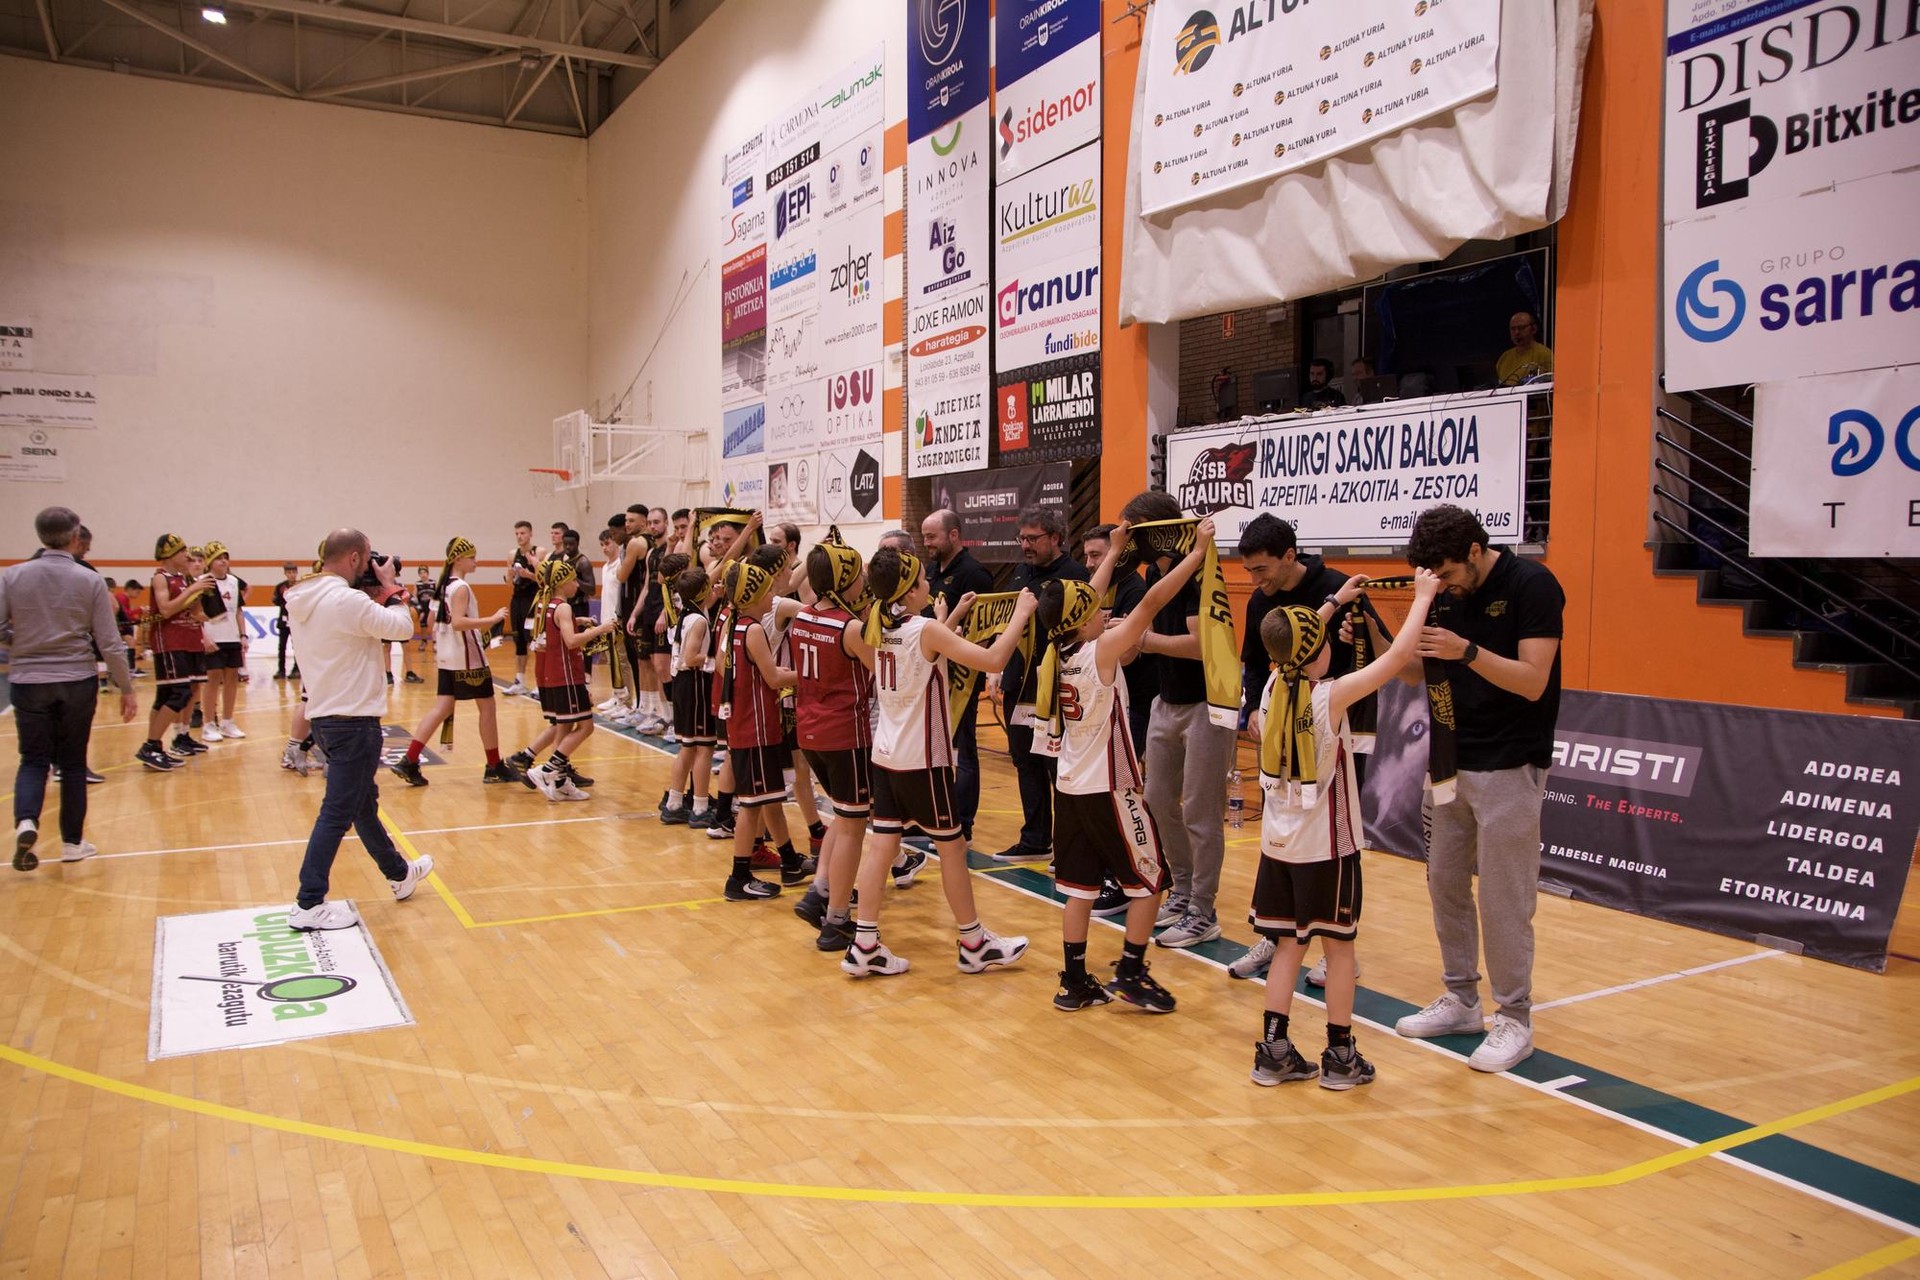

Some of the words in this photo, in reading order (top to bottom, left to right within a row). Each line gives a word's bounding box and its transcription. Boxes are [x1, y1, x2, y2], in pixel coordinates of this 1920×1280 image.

[1334, 34, 1360, 53] ALTUNA
[1366, 22, 1385, 37] URIA
[1377, 40, 1406, 60] ALTUNA
[1414, 28, 1434, 43] URIA
[1425, 46, 1456, 67] ALTUNA
[1464, 33, 1485, 50] URIA
[832, 64, 882, 109] alumak
[1245, 74, 1271, 90] ALTUNA
[1277, 64, 1293, 77] URIA
[1286, 83, 1314, 99] ALTUNA
[1321, 72, 1339, 85] URIA
[1332, 90, 1358, 108] ALTUNA
[1364, 79, 1383, 93] URIA
[1374, 99, 1403, 117] ALTUNA
[1411, 87, 1429, 101] URIA
[780, 102, 819, 140] CARMONA
[1017, 80, 1096, 143] sidenor
[1165, 107, 1191, 122] ALTUNA
[1195, 100, 1211, 111] URIA
[1204, 116, 1228, 131] ALTUNA
[1234, 108, 1249, 120] URIA
[1785, 87, 1920, 156] Bitxite
[1243, 126, 1269, 141] ALTUNA
[1275, 117, 1293, 129] URIA
[1287, 137, 1314, 152] ALTUNA
[1320, 127, 1337, 140] URIA
[785, 159, 798, 176] 151
[800, 148, 815, 167] 514
[918, 151, 978, 194] INNOVA
[1164, 155, 1188, 169] ALTUNA
[1194, 148, 1208, 159] URIA
[1202, 166, 1226, 180] ALTUNA
[1233, 158, 1248, 170] URIA
[1703, 120, 1717, 196] BITXITEGIA
[788, 182, 811, 223] EPI
[1001, 178, 1096, 237] Kulturaz
[723, 211, 765, 246] Sagarna
[929, 221, 955, 251] Aiz
[830, 245, 872, 298] zaher
[943, 246, 965, 274] Go
[1760, 246, 1845, 273] GRUPO
[998, 266, 1098, 325] aranur
[1759, 259, 1920, 331] sarra
[913, 310, 938, 334] JOXE
[942, 295, 984, 325] RAMON
[1071, 308, 1098, 320] OSAGAIAK
[925, 332, 969, 351] harategia
[1045, 330, 1098, 354] fundibide
[13, 387, 34, 396] IBAI
[38, 389, 71, 398] ONDO
[827, 368, 873, 412] IOSU
[1046, 372, 1094, 403] MILAR
[934, 394, 981, 416] JATETXEA
[1032, 398, 1095, 424] LARRAMENDI
[827, 410, 873, 434] OPTIKA
[917, 446, 981, 469] SAGARDOTEGIA
[1260, 432, 1332, 479] IRAURGI
[1336, 425, 1393, 474] SASKI
[1400, 415, 1480, 469] BALOIA
[827, 477, 842, 494] LATZ
[854, 472, 874, 491] LATZ
[1201, 461, 1226, 480] ISB
[964, 492, 1017, 509] JUARISTI
[1180, 481, 1251, 508] IRAURGI
[1260, 485, 1318, 507] AZPEITIA
[1329, 479, 1399, 504] AZKOITIA
[1412, 473, 1479, 500] ZESTOA
[1803, 760, 1901, 786] ADOREA
[1780, 790, 1893, 820] ADIMENA
[1766, 821, 1884, 853] LIDERGOA
[1549, 845, 1604, 865] BABESLE
[1608, 857, 1667, 879] NAGUSIA
[1786, 857, 1875, 888] TALDEA
[1719, 877, 1866, 921] ETORKIZUNA
[218, 941, 247, 978] barrutik
[217, 983, 253, 1028] ezagutu
